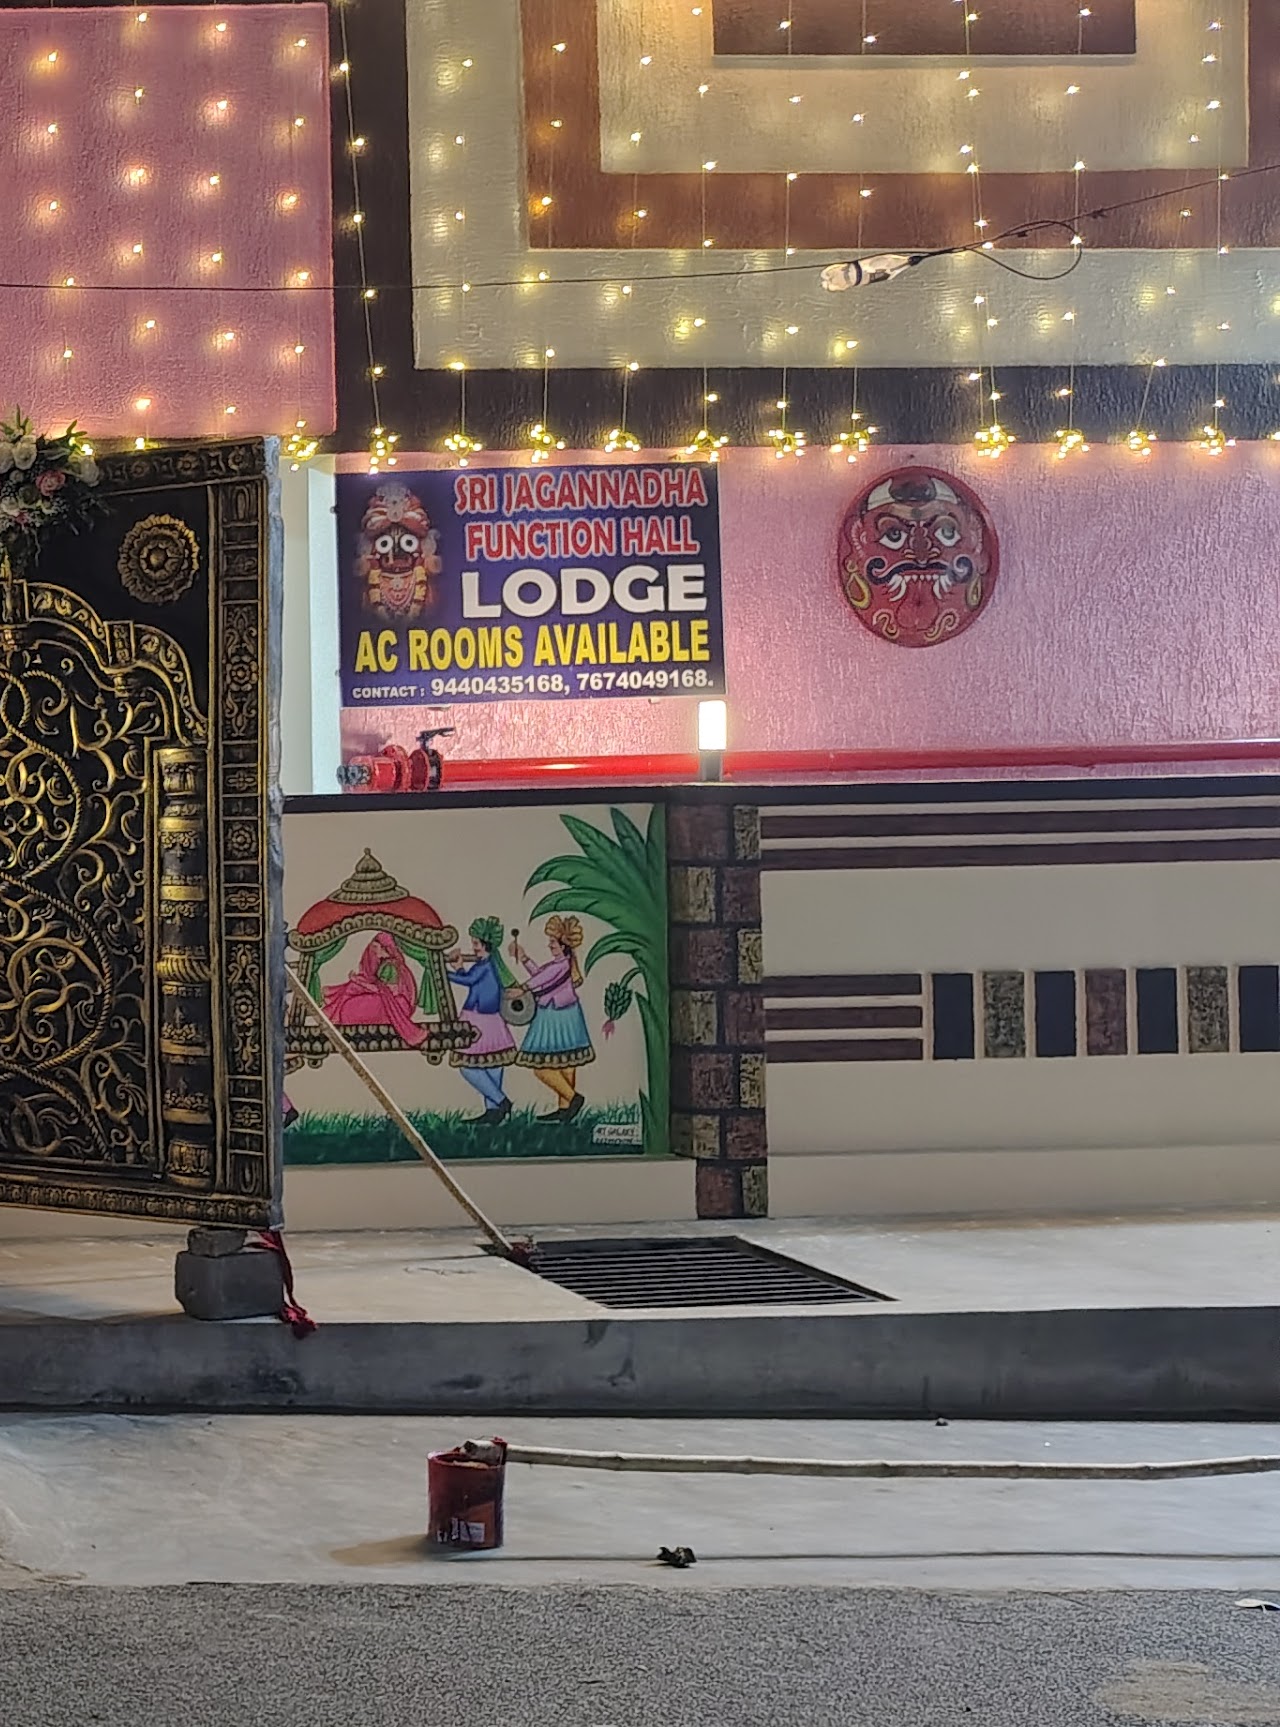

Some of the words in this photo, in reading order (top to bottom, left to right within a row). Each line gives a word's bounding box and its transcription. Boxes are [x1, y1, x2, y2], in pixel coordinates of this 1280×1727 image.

[455, 474, 496, 514] SRI
[504, 468, 707, 515] JAGANNADHA
[466, 519, 617, 560] FUNCTION
[622, 515, 699, 555] HALL
[462, 564, 706, 618] LODGE
[354, 630, 398, 672] AC
[409, 625, 523, 670] ROOMS
[533, 619, 710, 666] AVAILABLE
[352, 685, 418, 699] CONTACT
[431, 674, 570, 696] 9440435168,
